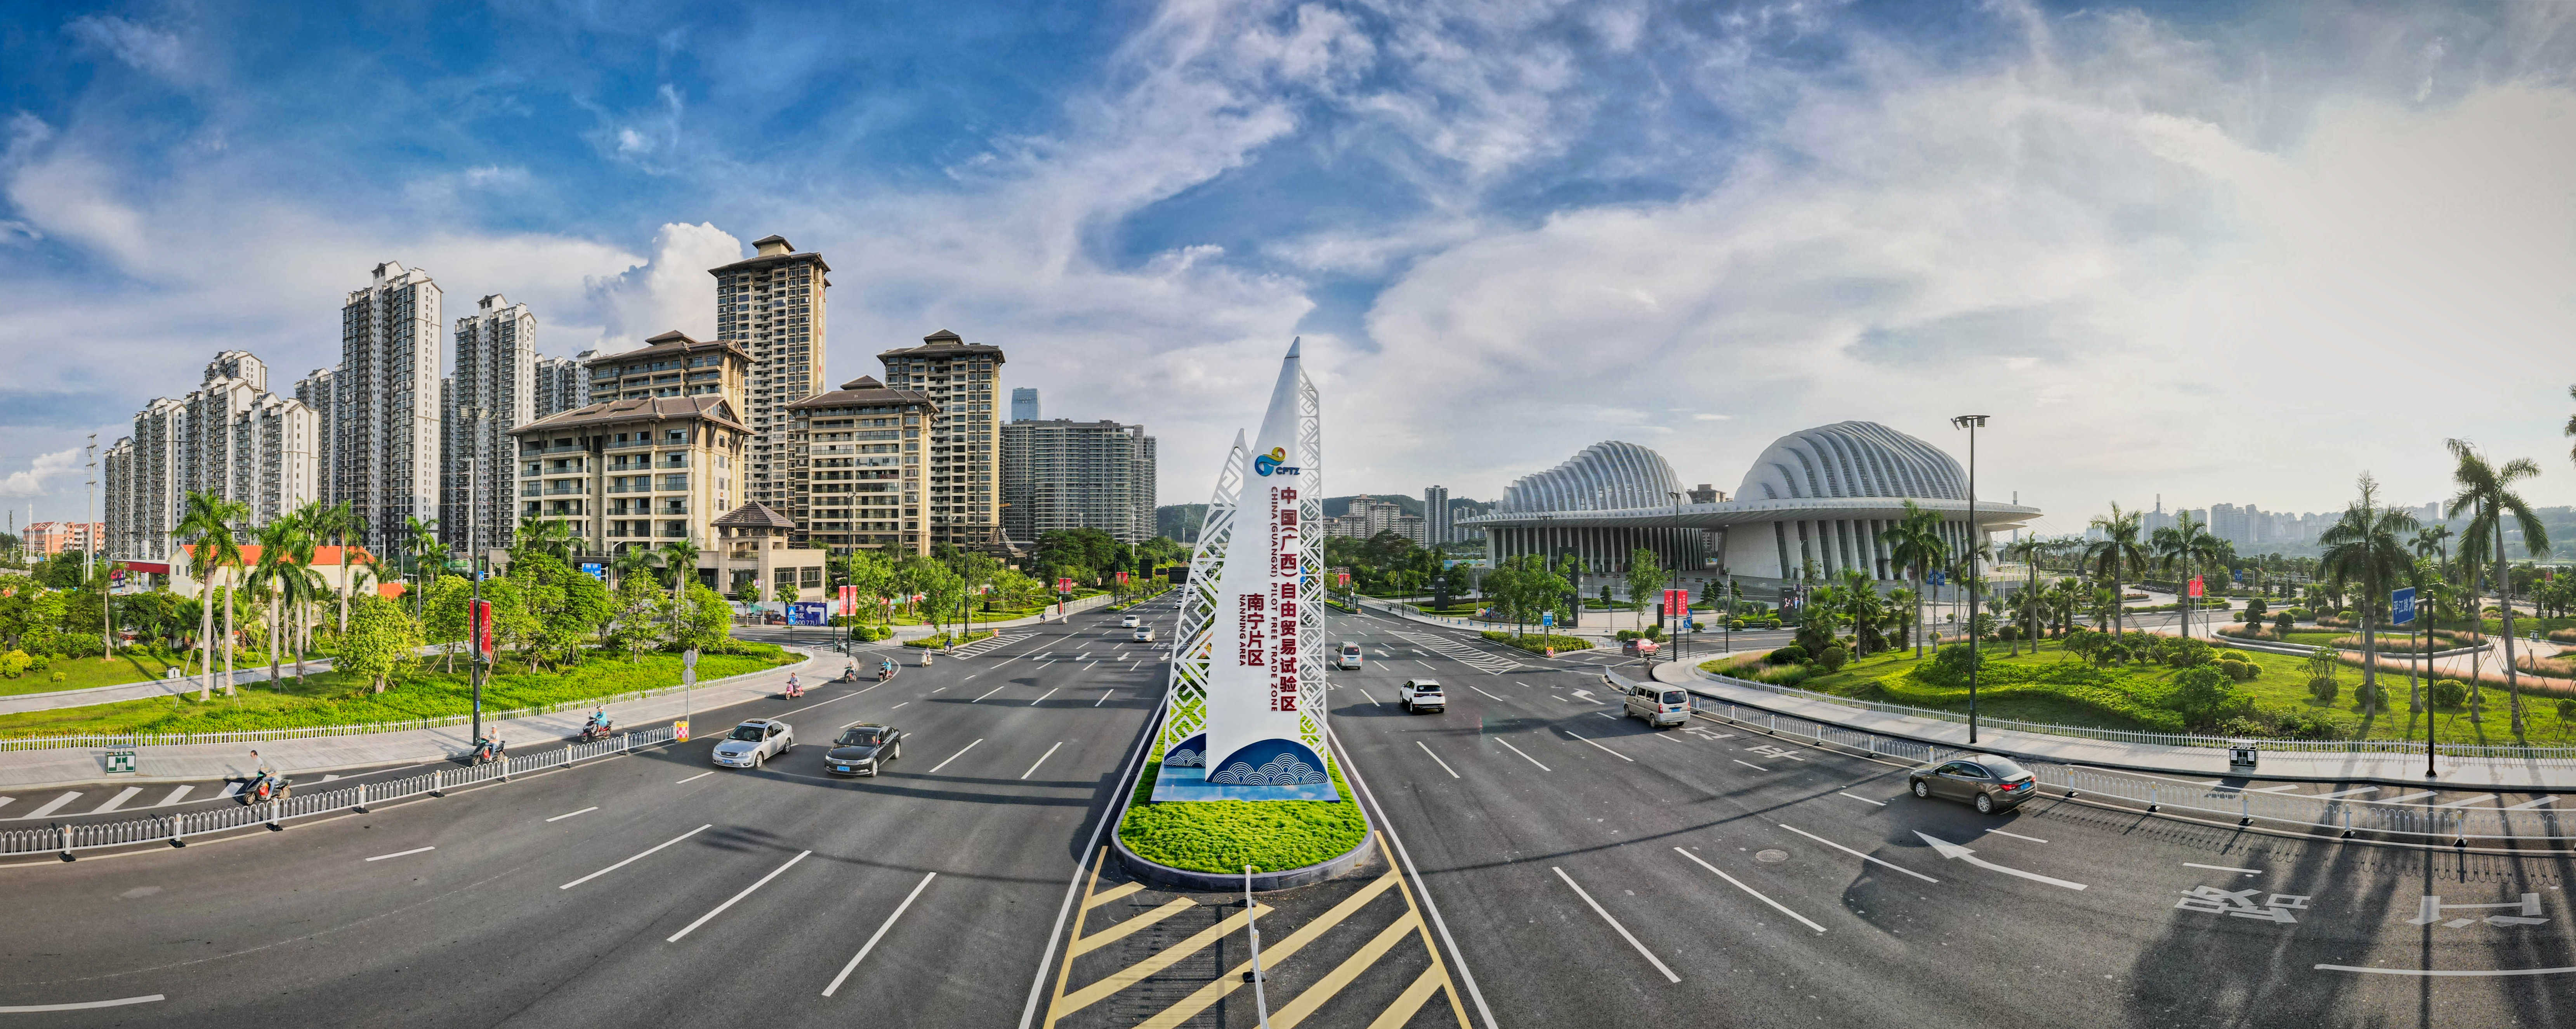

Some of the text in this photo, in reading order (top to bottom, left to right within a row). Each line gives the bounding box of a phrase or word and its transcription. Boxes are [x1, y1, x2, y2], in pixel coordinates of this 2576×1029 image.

[2393, 598, 2408, 615] 平江路
[1247, 593, 1264, 666] 南宁片区
